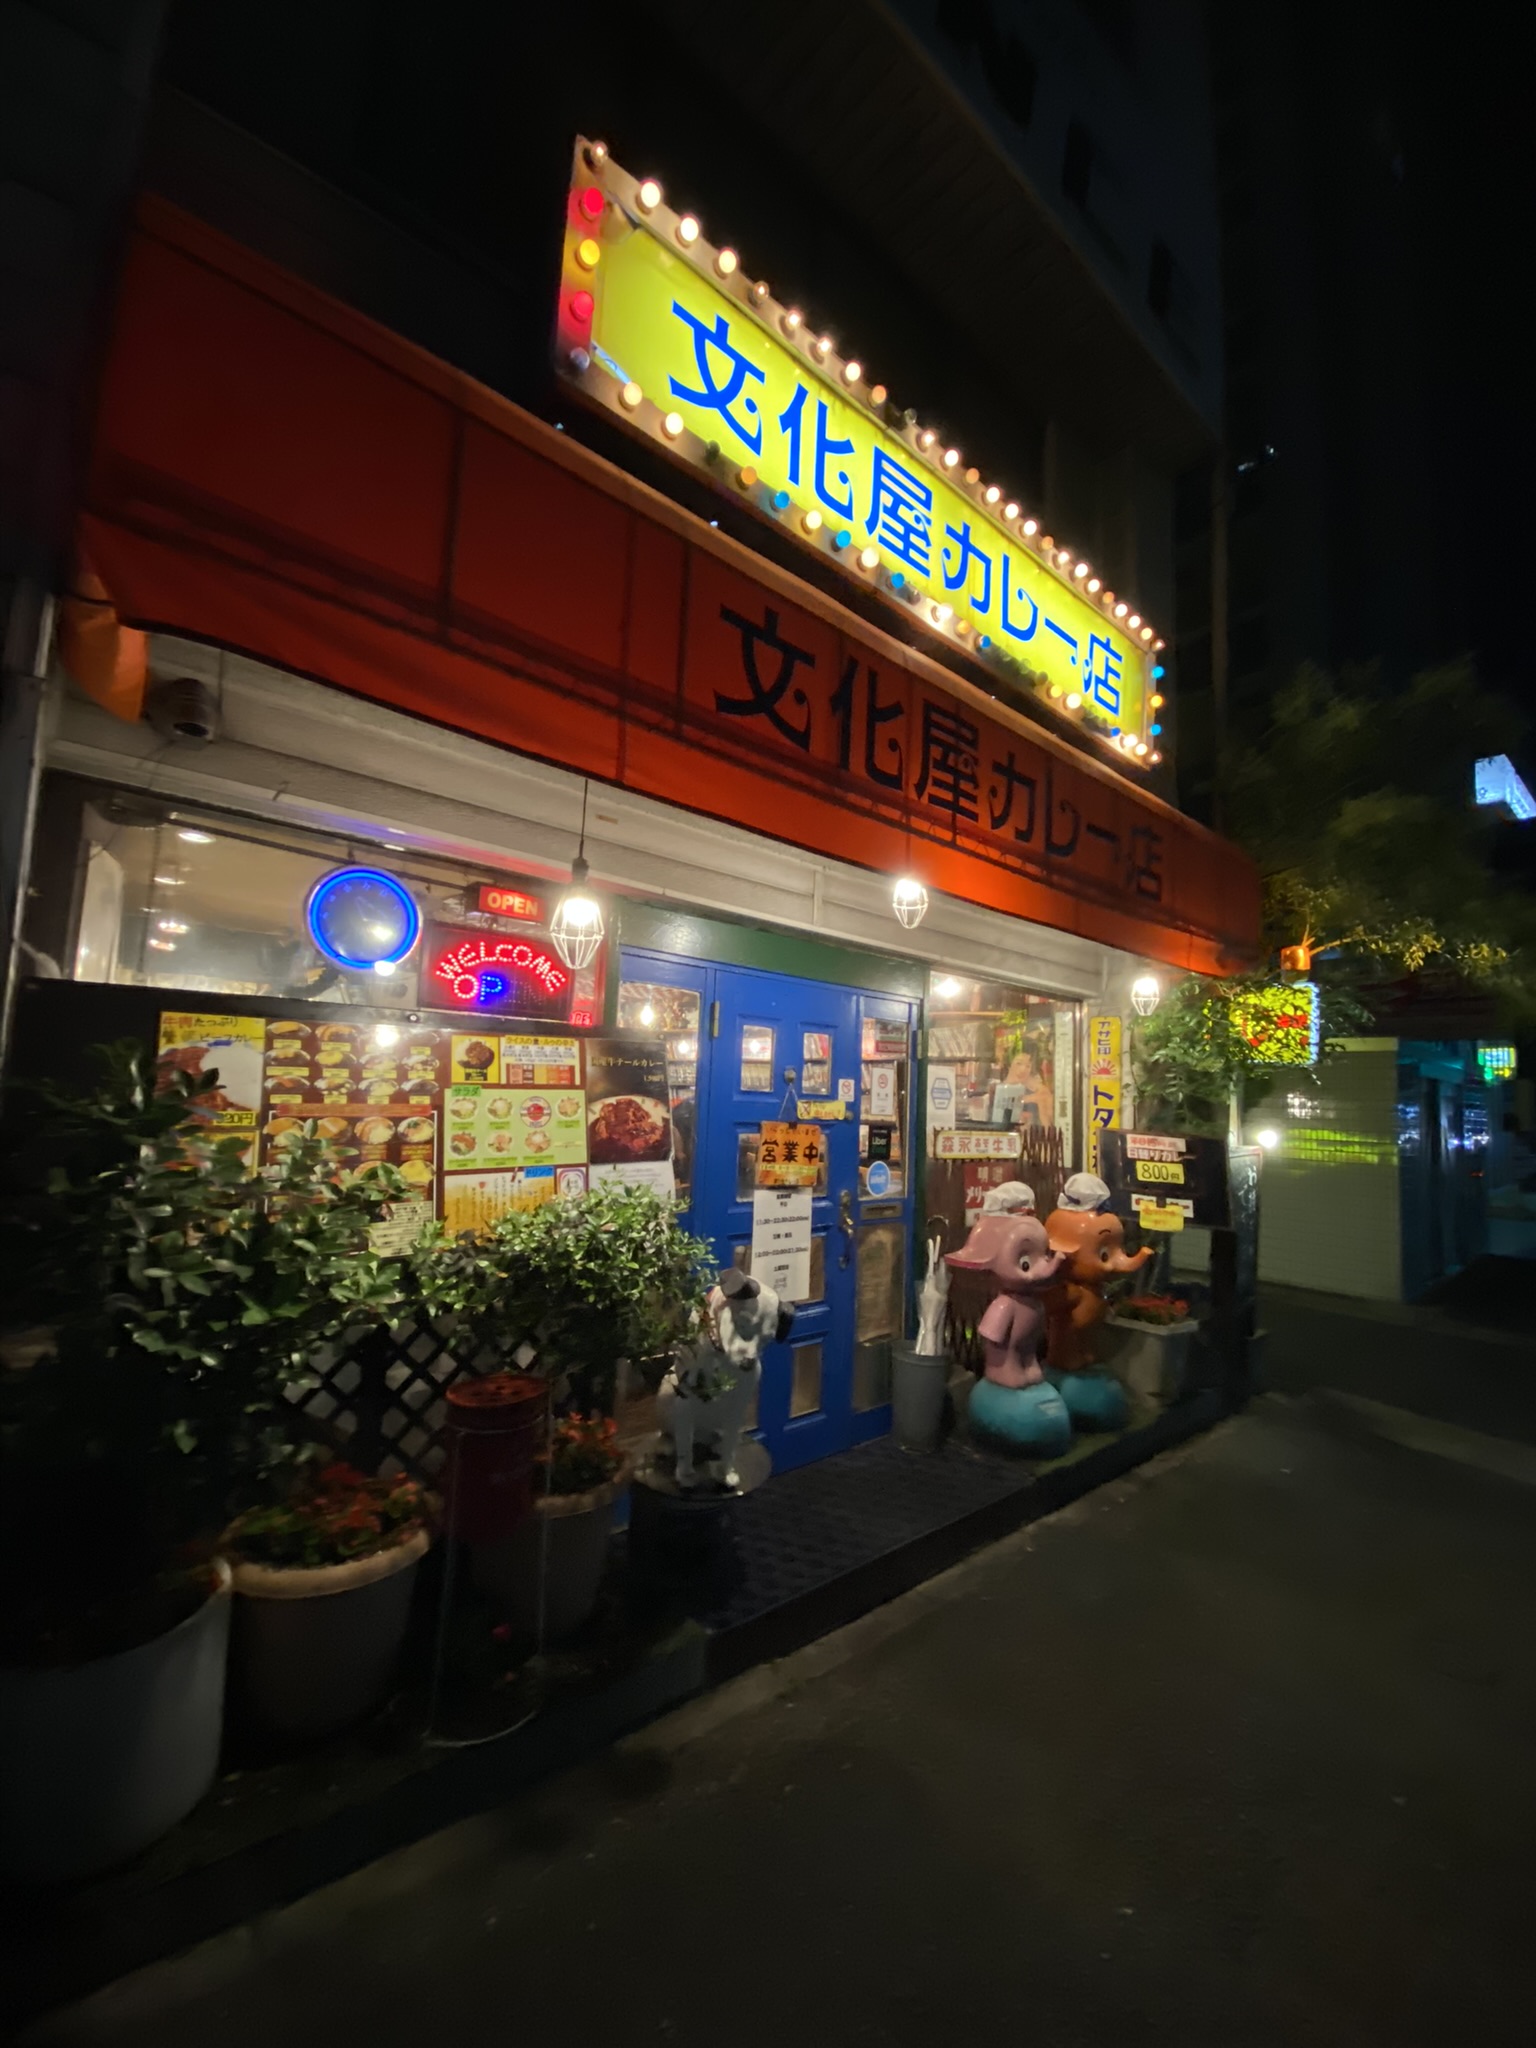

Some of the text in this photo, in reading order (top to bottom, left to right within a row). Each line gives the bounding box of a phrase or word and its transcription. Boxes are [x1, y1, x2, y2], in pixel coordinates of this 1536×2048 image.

[666, 299, 1125, 719] 文化屋カレー店
[714, 604, 1165, 903] 文化屋カレー店
[487, 892, 538, 917] OPEN
[435, 941, 566, 993] WELCOME
[1097, 1021, 1111, 1055] アサヒ印
[762, 1139, 819, 1165] 営業中
[872, 1136, 887, 1146] Uber
